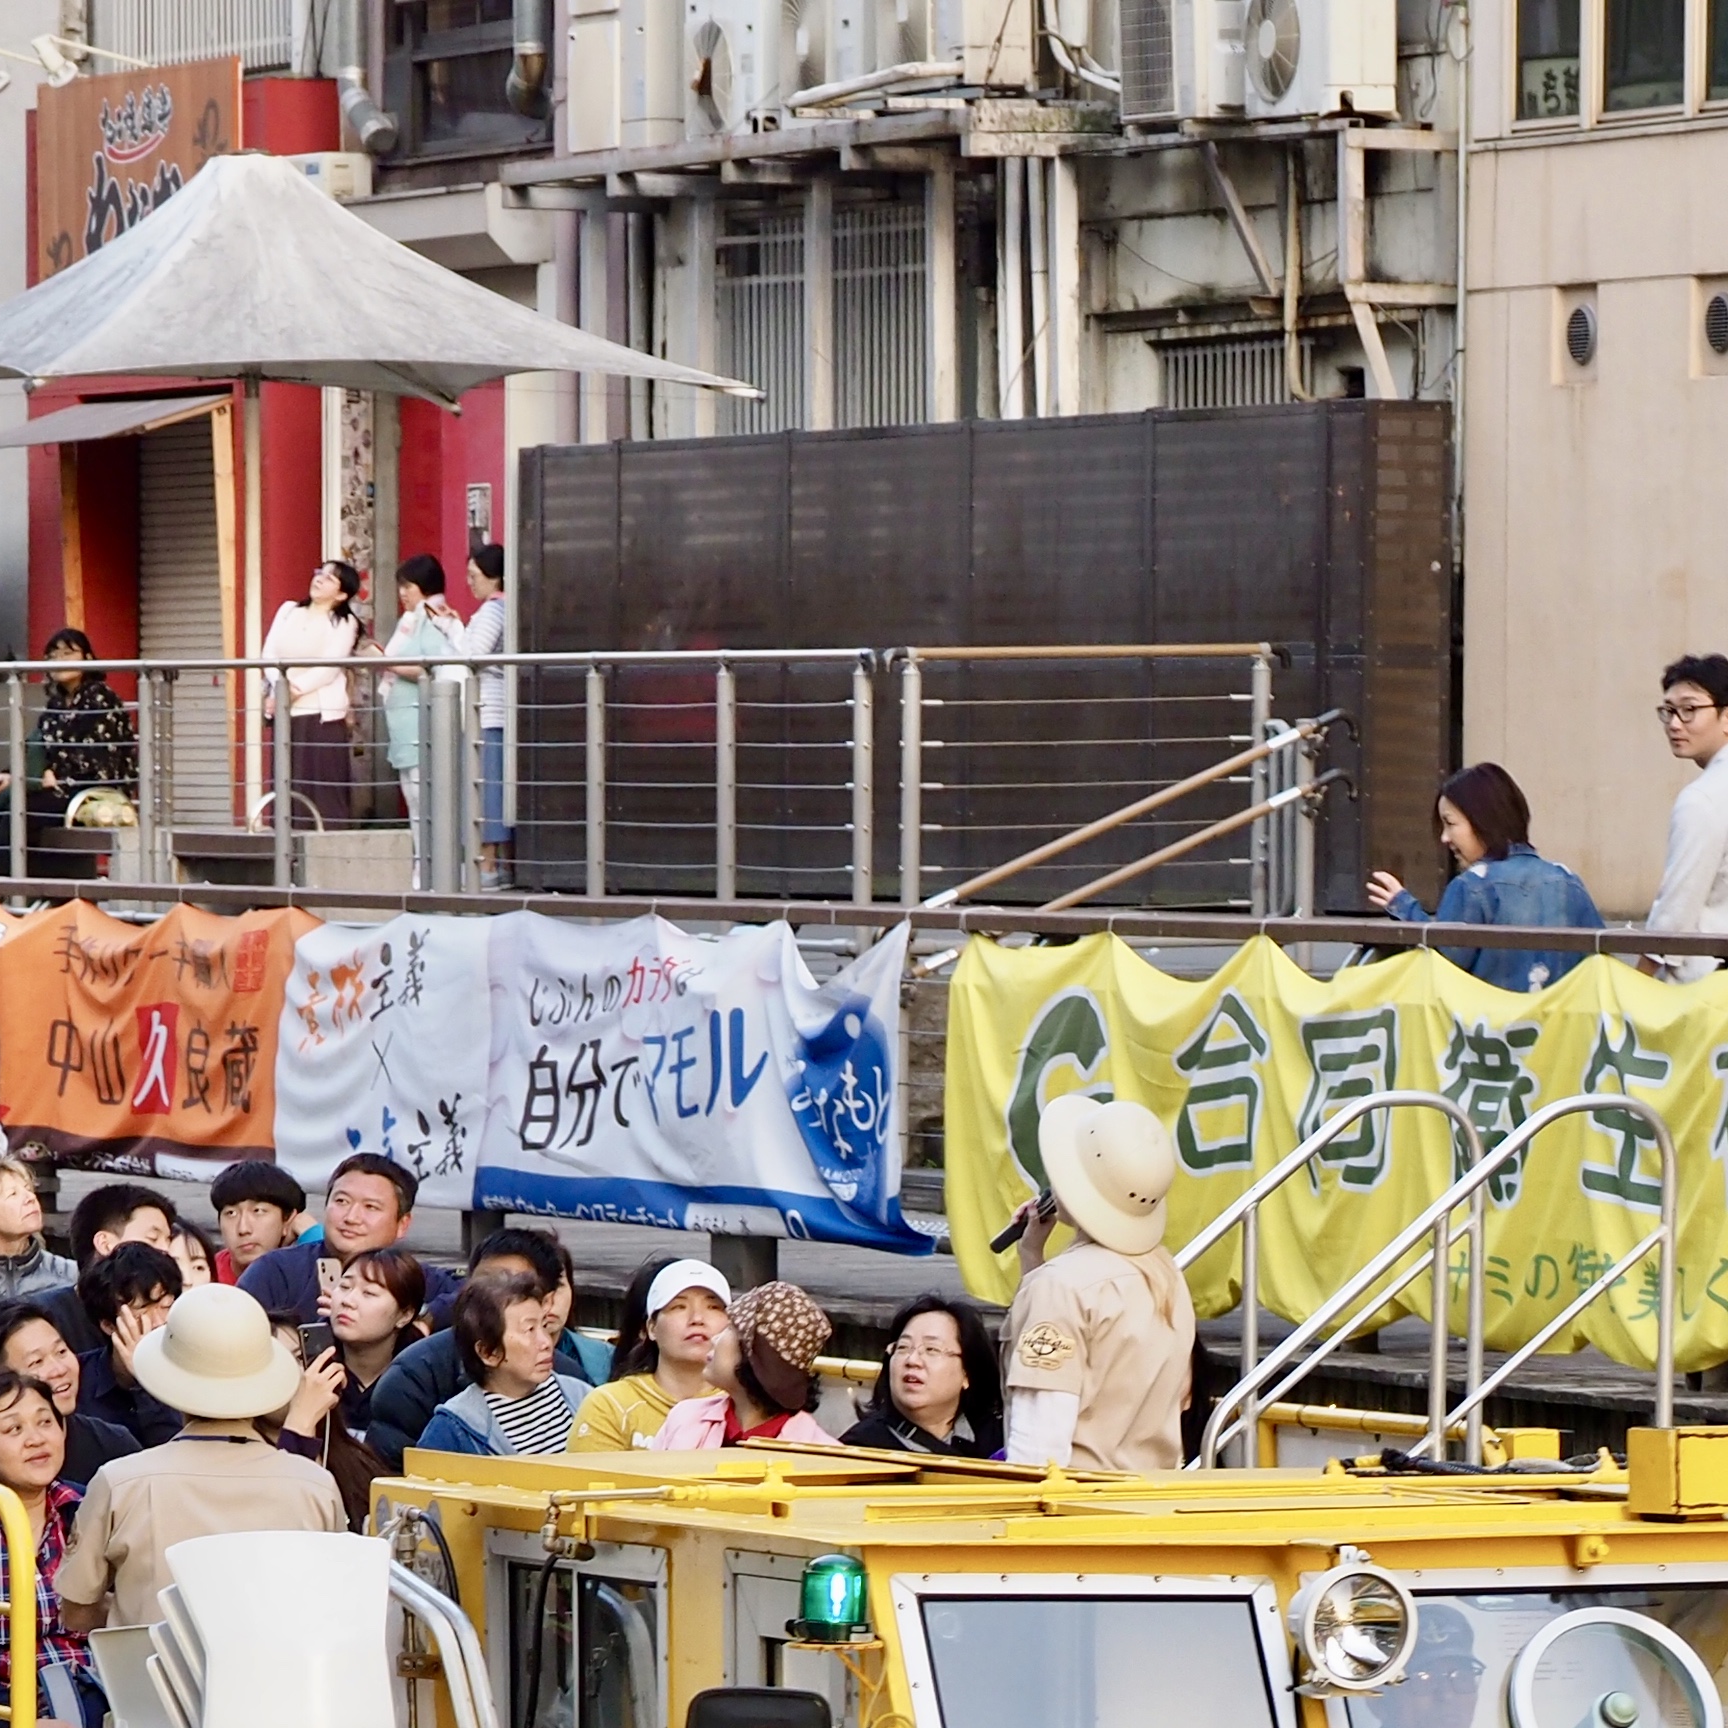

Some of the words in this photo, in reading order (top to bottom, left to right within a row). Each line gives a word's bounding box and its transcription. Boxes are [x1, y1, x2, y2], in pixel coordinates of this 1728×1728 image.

[520, 1007, 769, 1151] 自分でマモル
